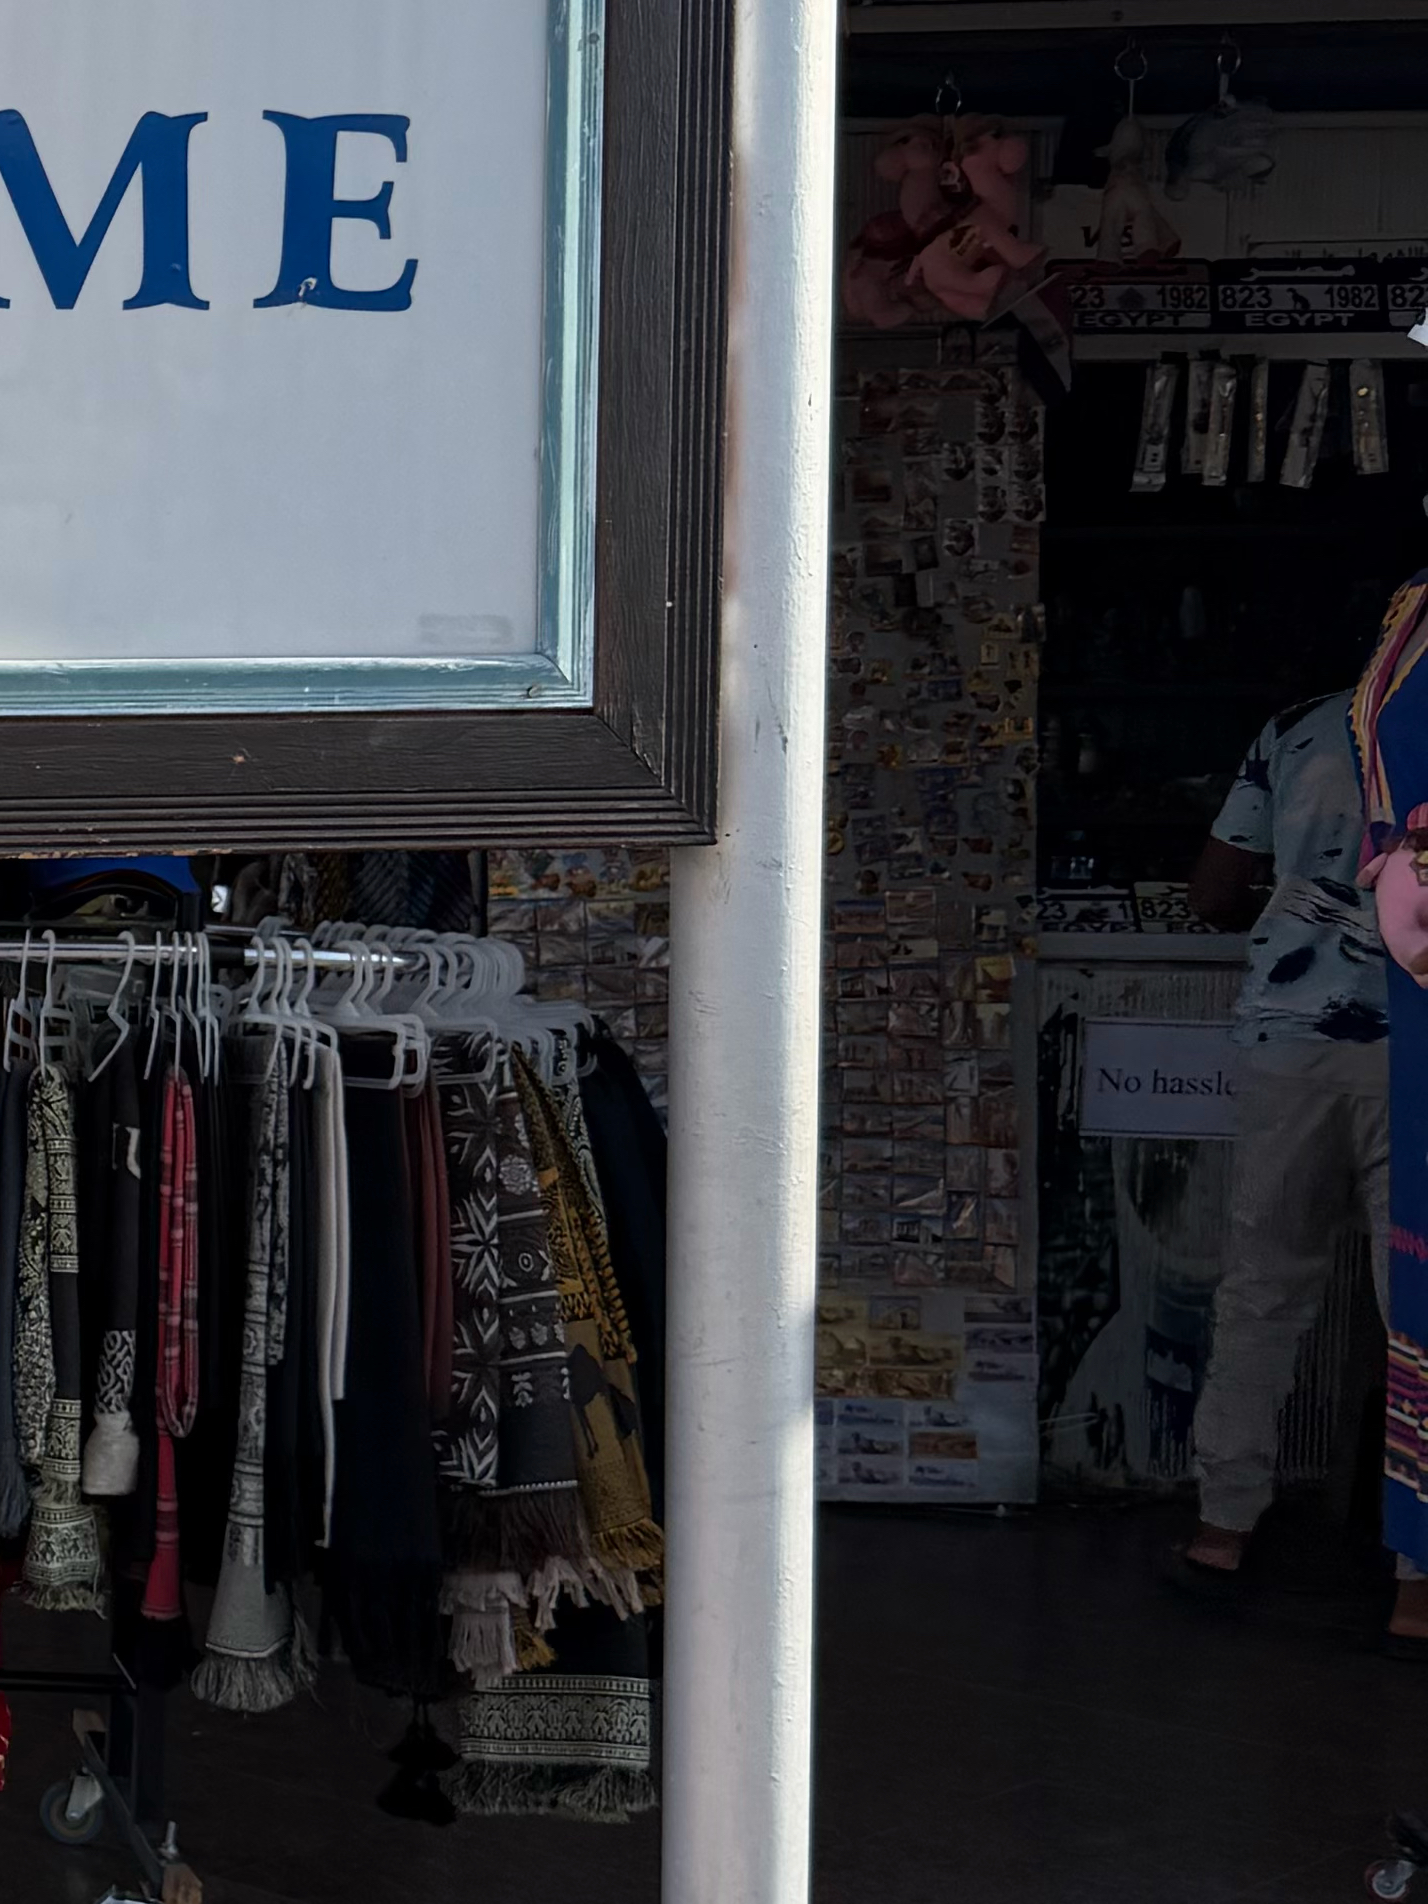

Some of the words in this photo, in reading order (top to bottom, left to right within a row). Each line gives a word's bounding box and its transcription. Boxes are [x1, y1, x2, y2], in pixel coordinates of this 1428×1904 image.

[1070, 285, 1105, 309] 23
[1156, 285, 1208, 309] 1982
[1221, 286, 1273, 310] 823
[1324, 286, 1377, 309] 1982
[1391, 285, 1428, 308] 82
[1077, 312, 1184, 327] EGYPT
[1245, 312, 1355, 327] EGYPT
[1037, 902, 1067, 919] 23
[1141, 899, 1191, 919] 823
[1097, 1067, 1141, 1094] No
